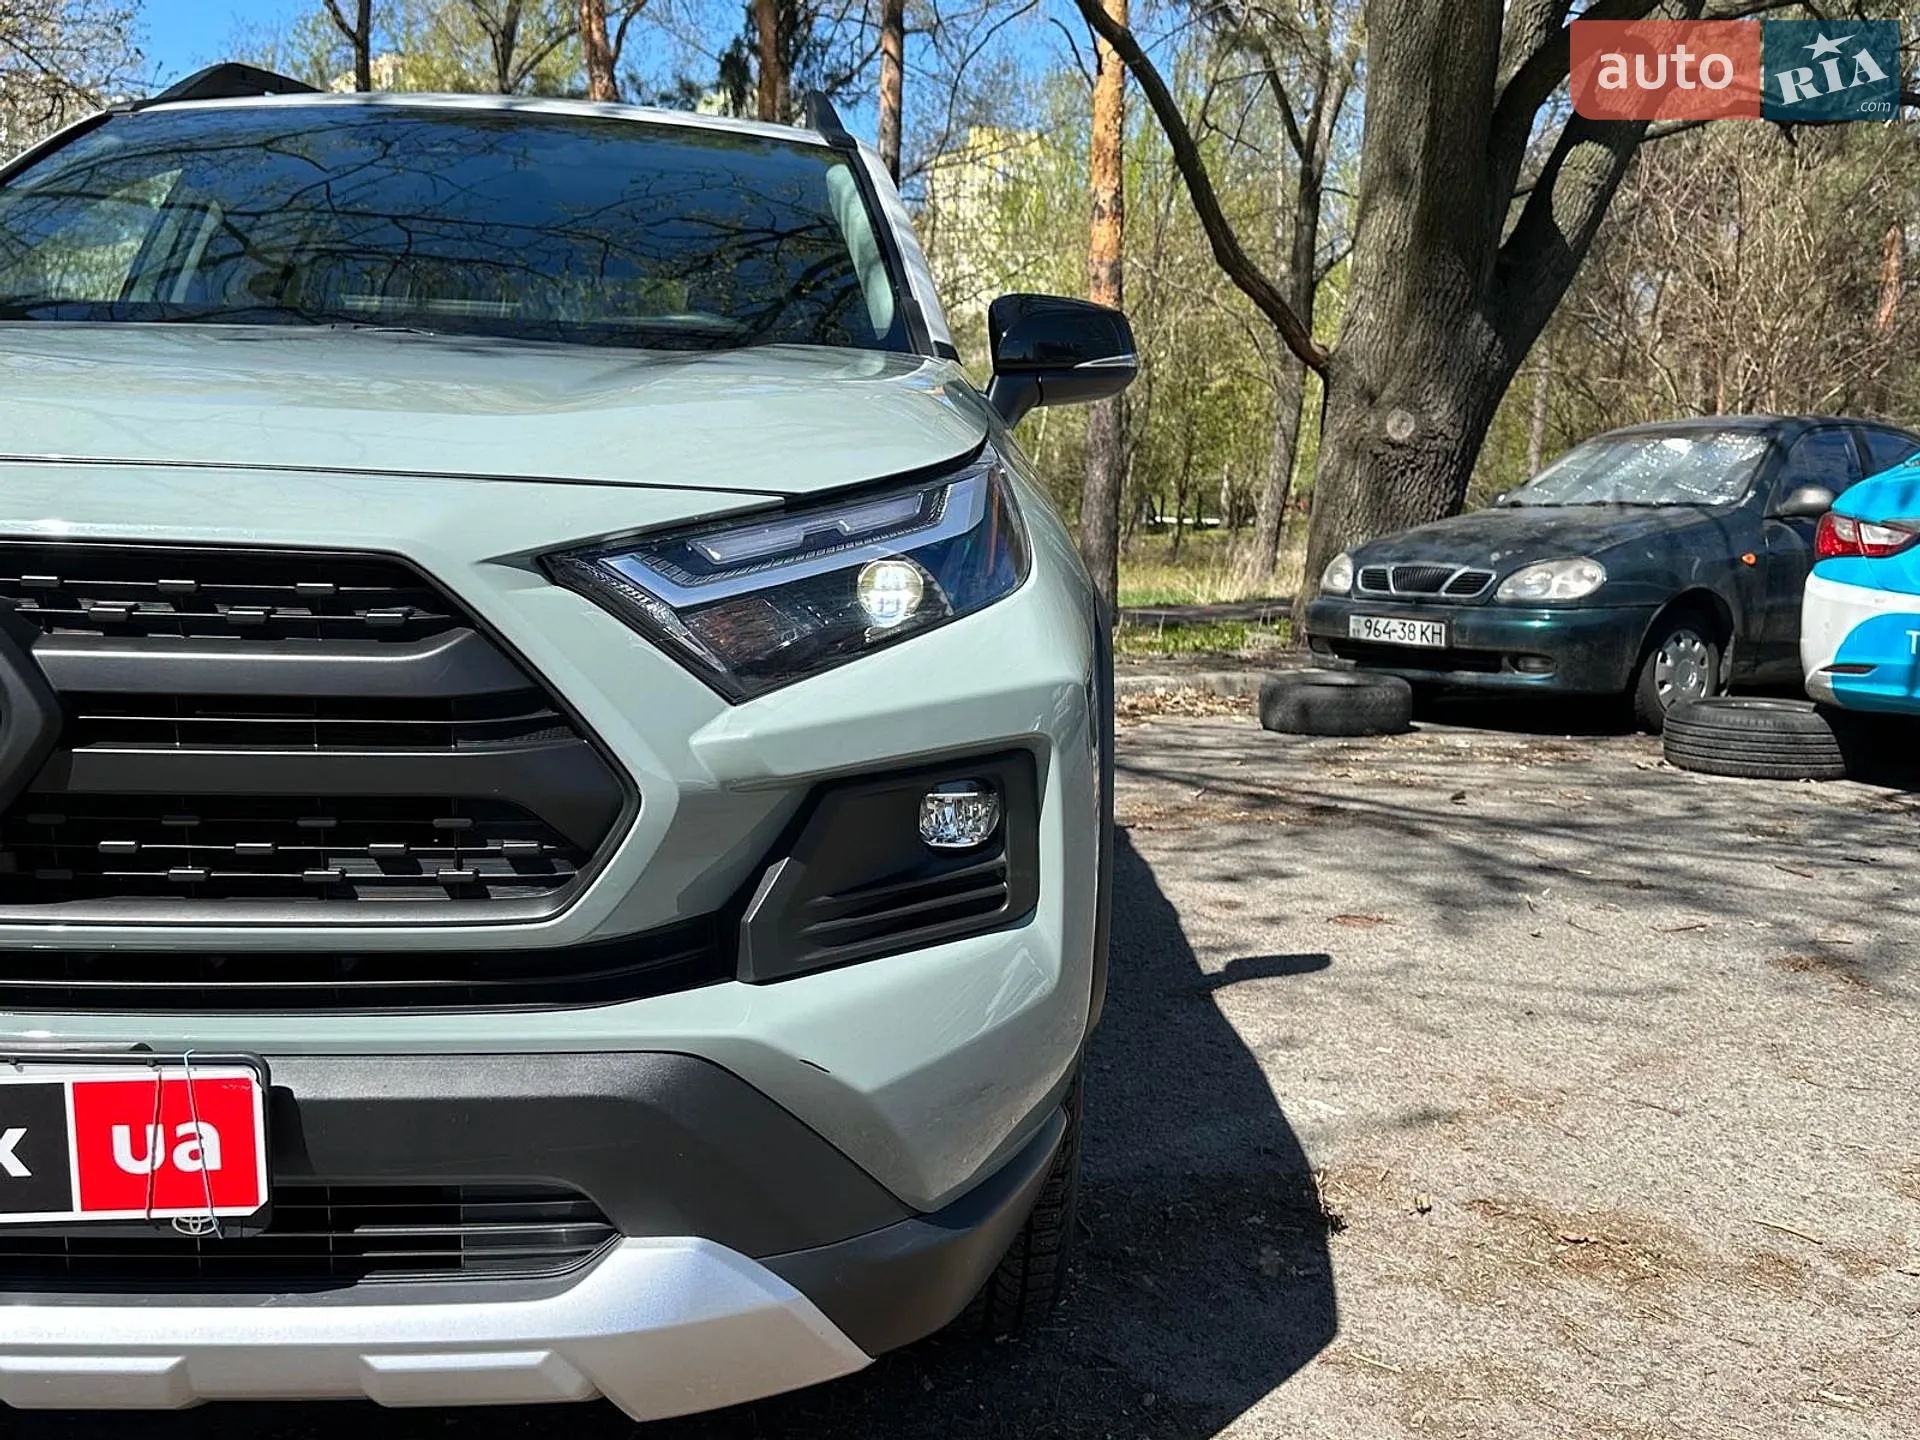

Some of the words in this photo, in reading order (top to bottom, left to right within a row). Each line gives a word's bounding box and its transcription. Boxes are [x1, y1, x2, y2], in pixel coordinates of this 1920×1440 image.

[1364, 618, 1416, 641] 964-38
[1420, 623, 1443, 644] KH
[111, 1120, 222, 1175] ua
